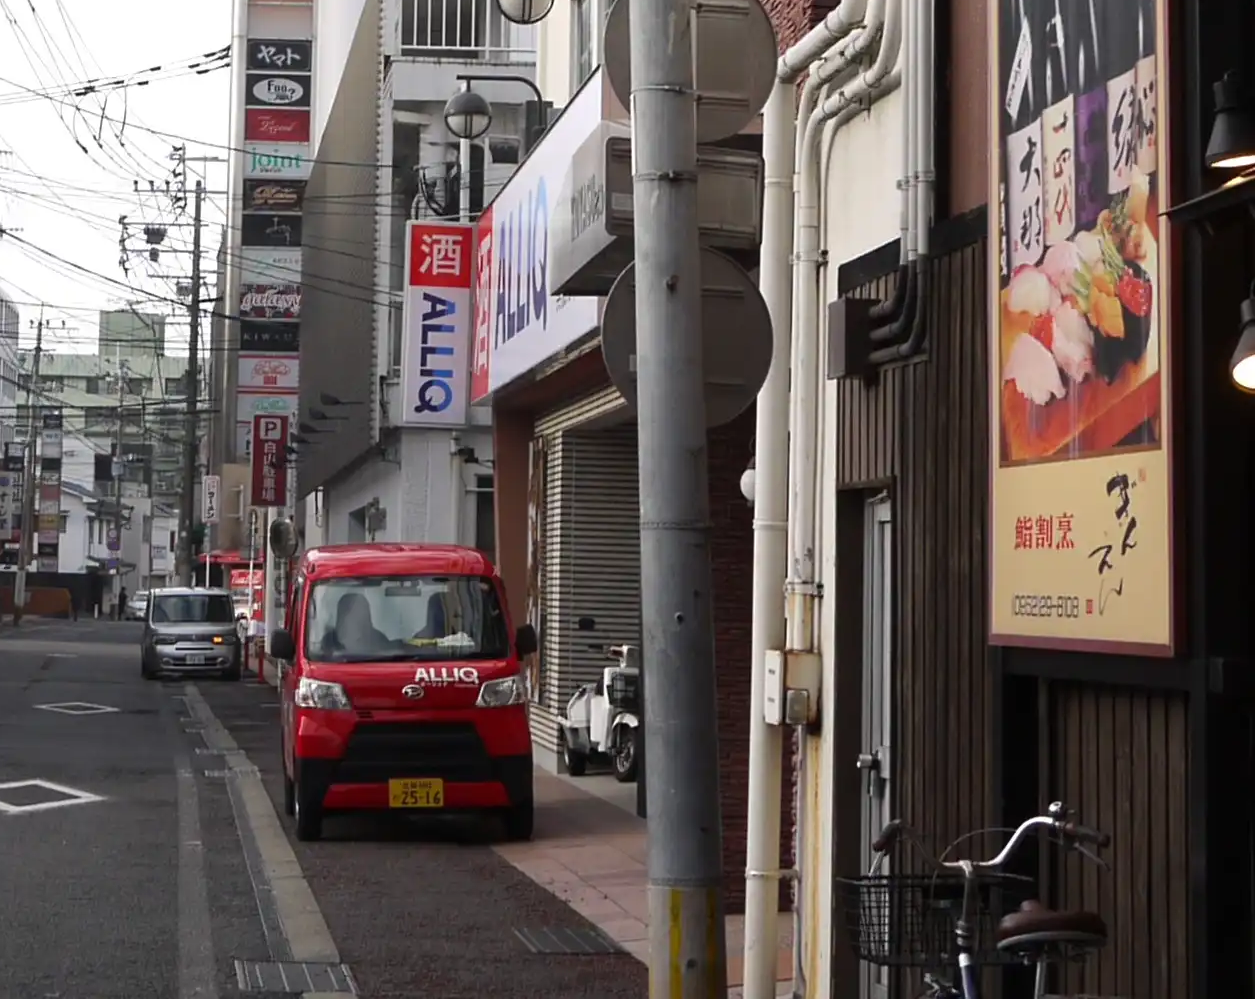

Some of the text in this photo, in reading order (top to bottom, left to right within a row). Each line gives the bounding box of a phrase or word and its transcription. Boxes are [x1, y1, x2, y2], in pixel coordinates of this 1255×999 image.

[256, 44, 302, 67] ヤマト
[419, 234, 463, 277] 酒
[495, 173, 548, 351] ALLIQ
[414, 292, 456, 413] ALLIQ
[264, 421, 277, 437] P
[1014, 512, 1076, 550] 鮨割烹
[414, 667, 479, 684] ALLIQ
